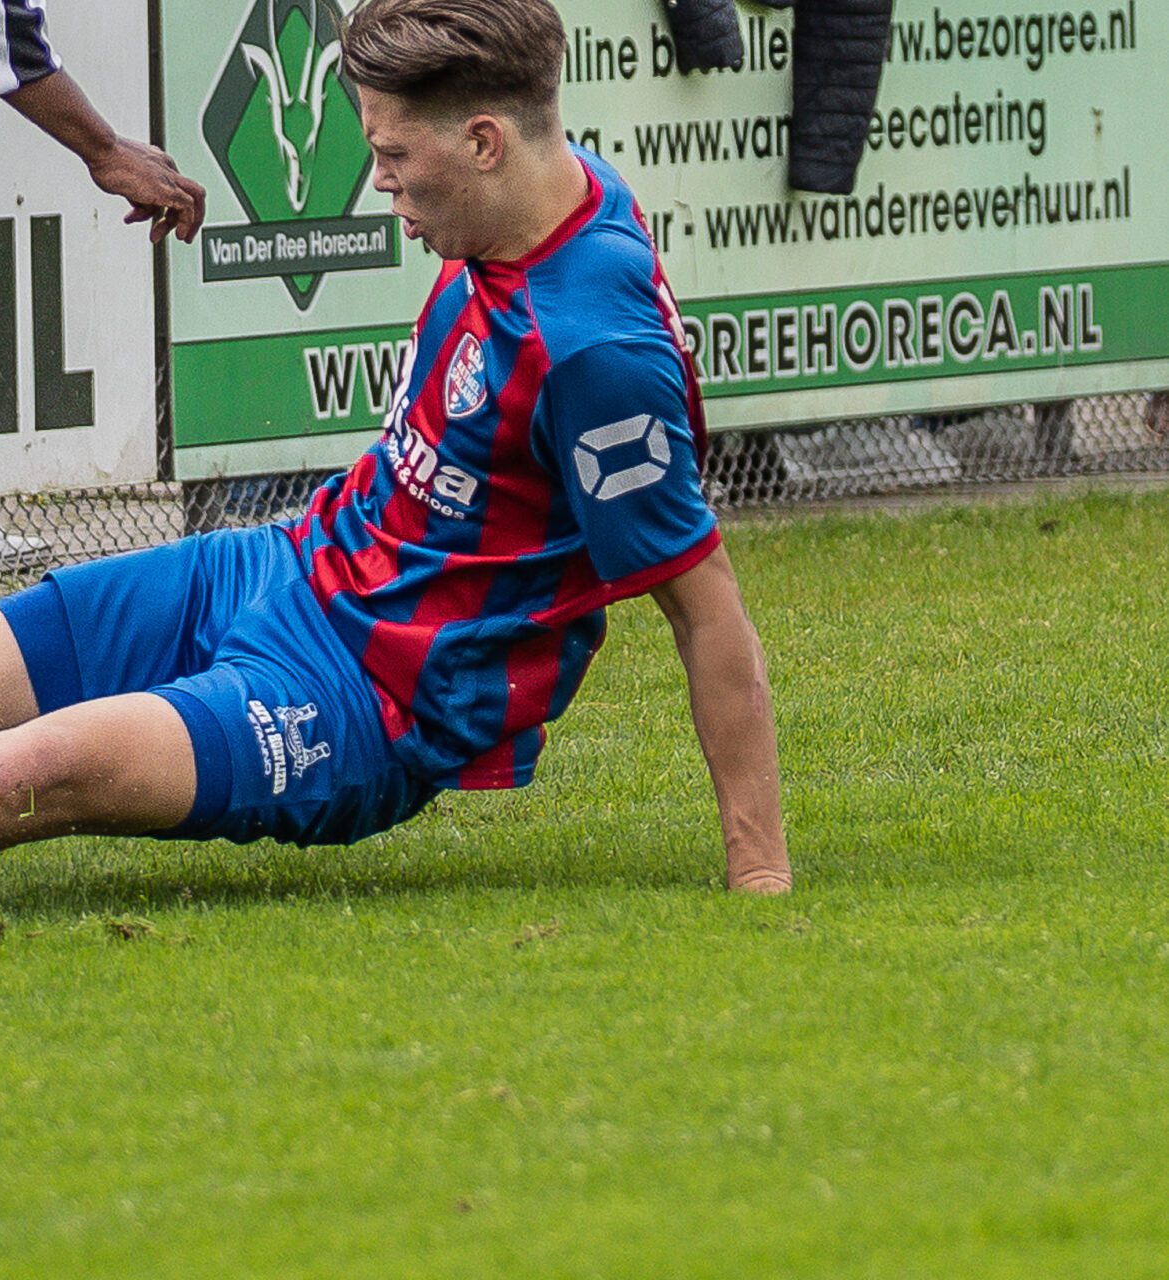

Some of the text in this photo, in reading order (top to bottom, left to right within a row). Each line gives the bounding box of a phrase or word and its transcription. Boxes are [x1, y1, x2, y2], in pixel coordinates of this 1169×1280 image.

[705, 165, 1131, 249] www.vanderreeverhuur.nl
[209, 225, 387, 265] Van Der Ree Horeca.nl
[384, 370, 478, 506] ima
[408, 483, 466, 520] shoes
